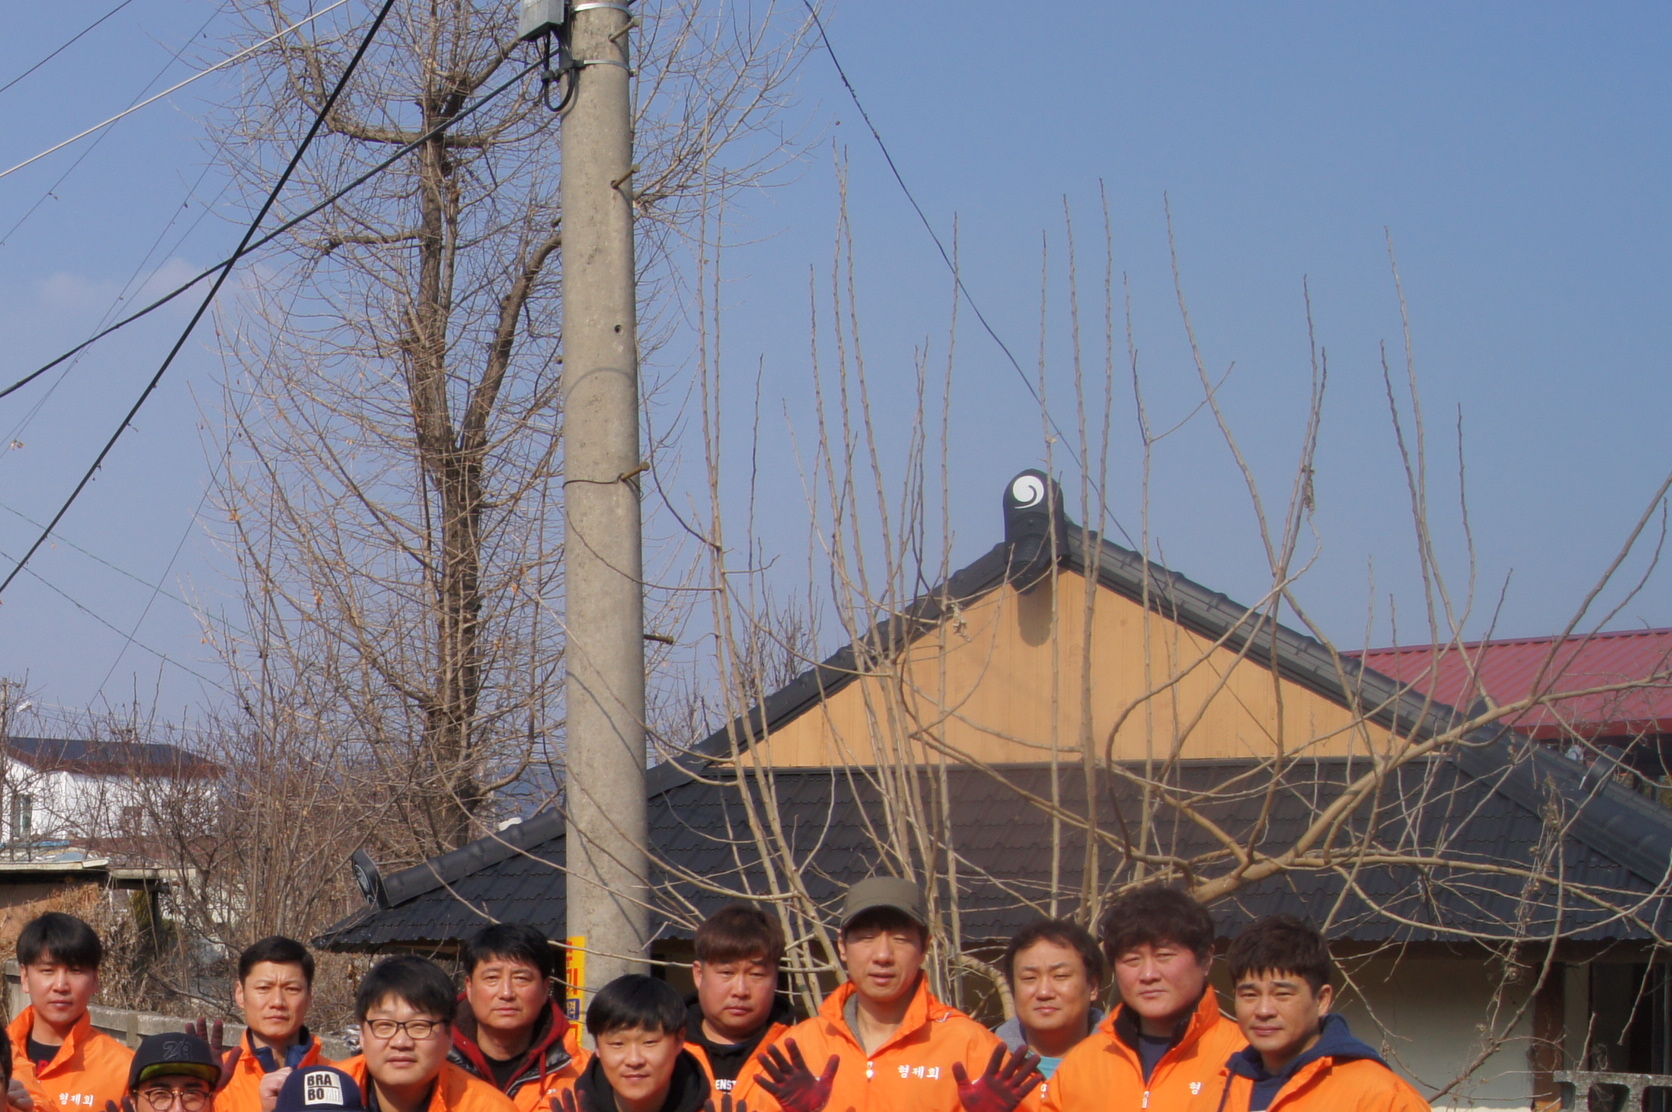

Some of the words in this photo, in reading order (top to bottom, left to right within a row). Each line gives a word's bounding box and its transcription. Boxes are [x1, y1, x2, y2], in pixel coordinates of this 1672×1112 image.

[897, 1064, 940, 1080] 형제회
[307, 1074, 332, 1086] BRA
[59, 1092, 94, 1107] 형제회
[308, 1088, 325, 1101] BO
